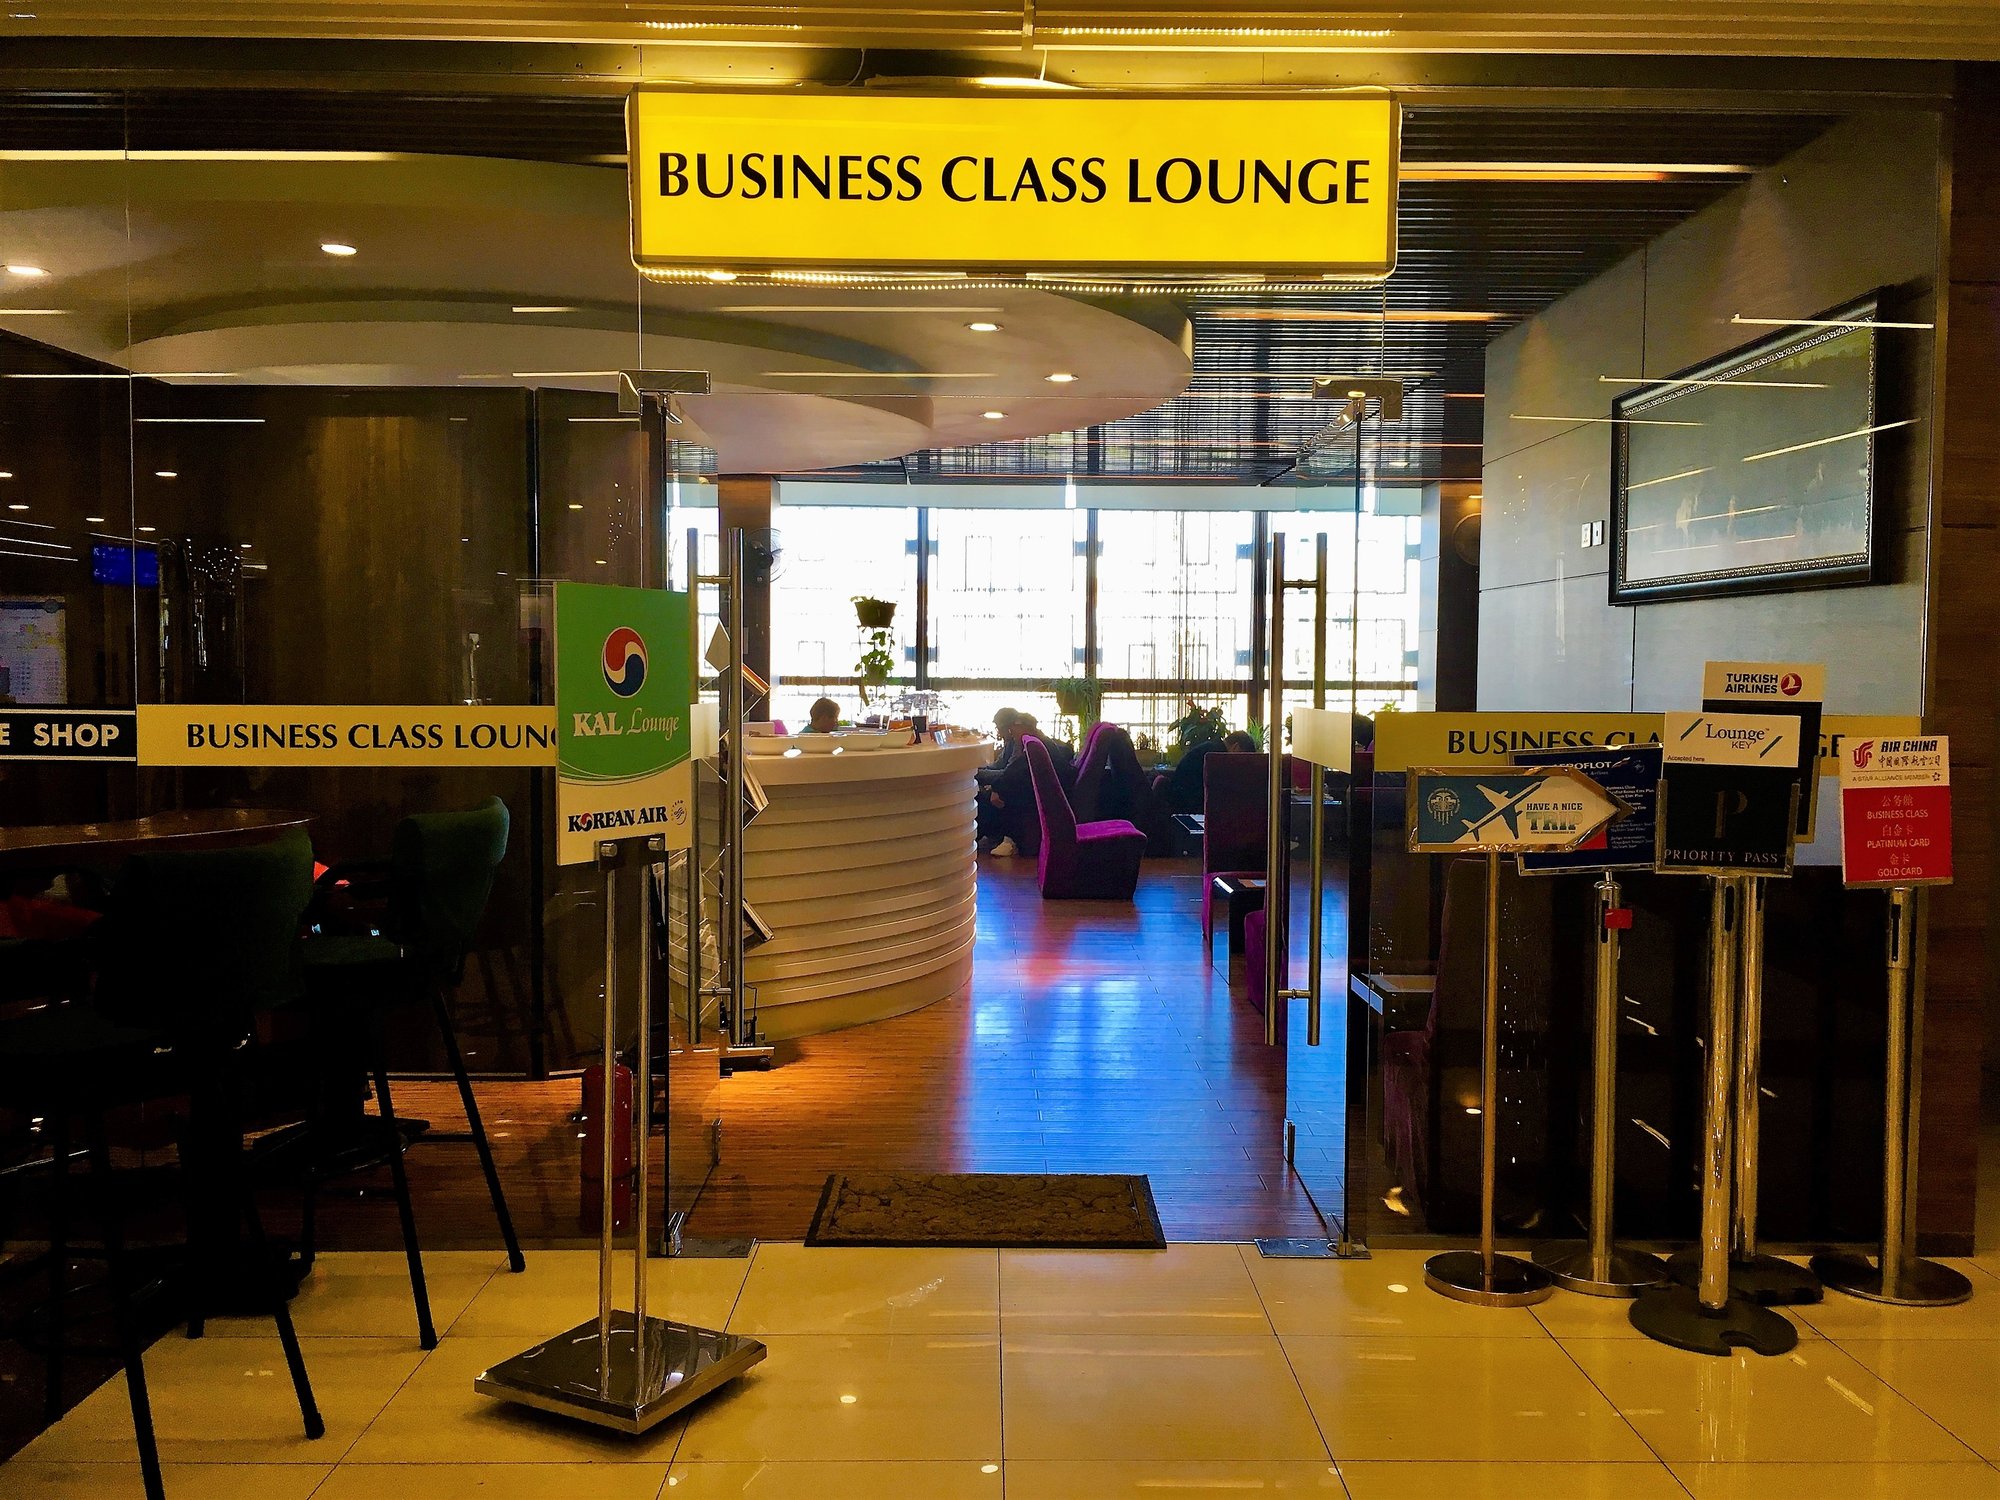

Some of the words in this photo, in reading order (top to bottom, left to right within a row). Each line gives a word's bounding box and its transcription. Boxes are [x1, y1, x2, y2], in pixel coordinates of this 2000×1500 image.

[659, 152, 922, 201] BUSINESS
[941, 155, 1107, 202] CLASS
[1128, 158, 1370, 204] LOUNGE
[1726, 673, 1778, 683] TURKISH
[1725, 684, 1778, 694] AIRLINES
[573, 712, 623, 737] KAL
[626, 707, 680, 741] Lounge
[33, 723, 120, 747] SHOP
[187, 723, 338, 749] BUSINESS
[348, 724, 443, 749] CLASS
[455, 724, 556, 749] LOUN
[1731, 741, 1753, 749] KEY
[1881, 741, 1901, 752] AIR
[1903, 740, 1938, 752] CHINA
[1561, 802, 1583, 810] NICE
[568, 809, 636, 832] KOREAN
[637, 806, 668, 824] AIR
[1867, 810, 1904, 819] BUSINESS
[1905, 809, 1928, 818] CLASS
[1526, 811, 1583, 830] TRIP
[1867, 839, 1908, 849] PLATINUM
[1909, 838, 1930, 847] CARD
[1664, 849, 1735, 863] PRIORITY
[1744, 852, 1778, 864] PASS
[1878, 868, 1900, 877] GOLD
[1901, 866, 1923, 876] CARD
